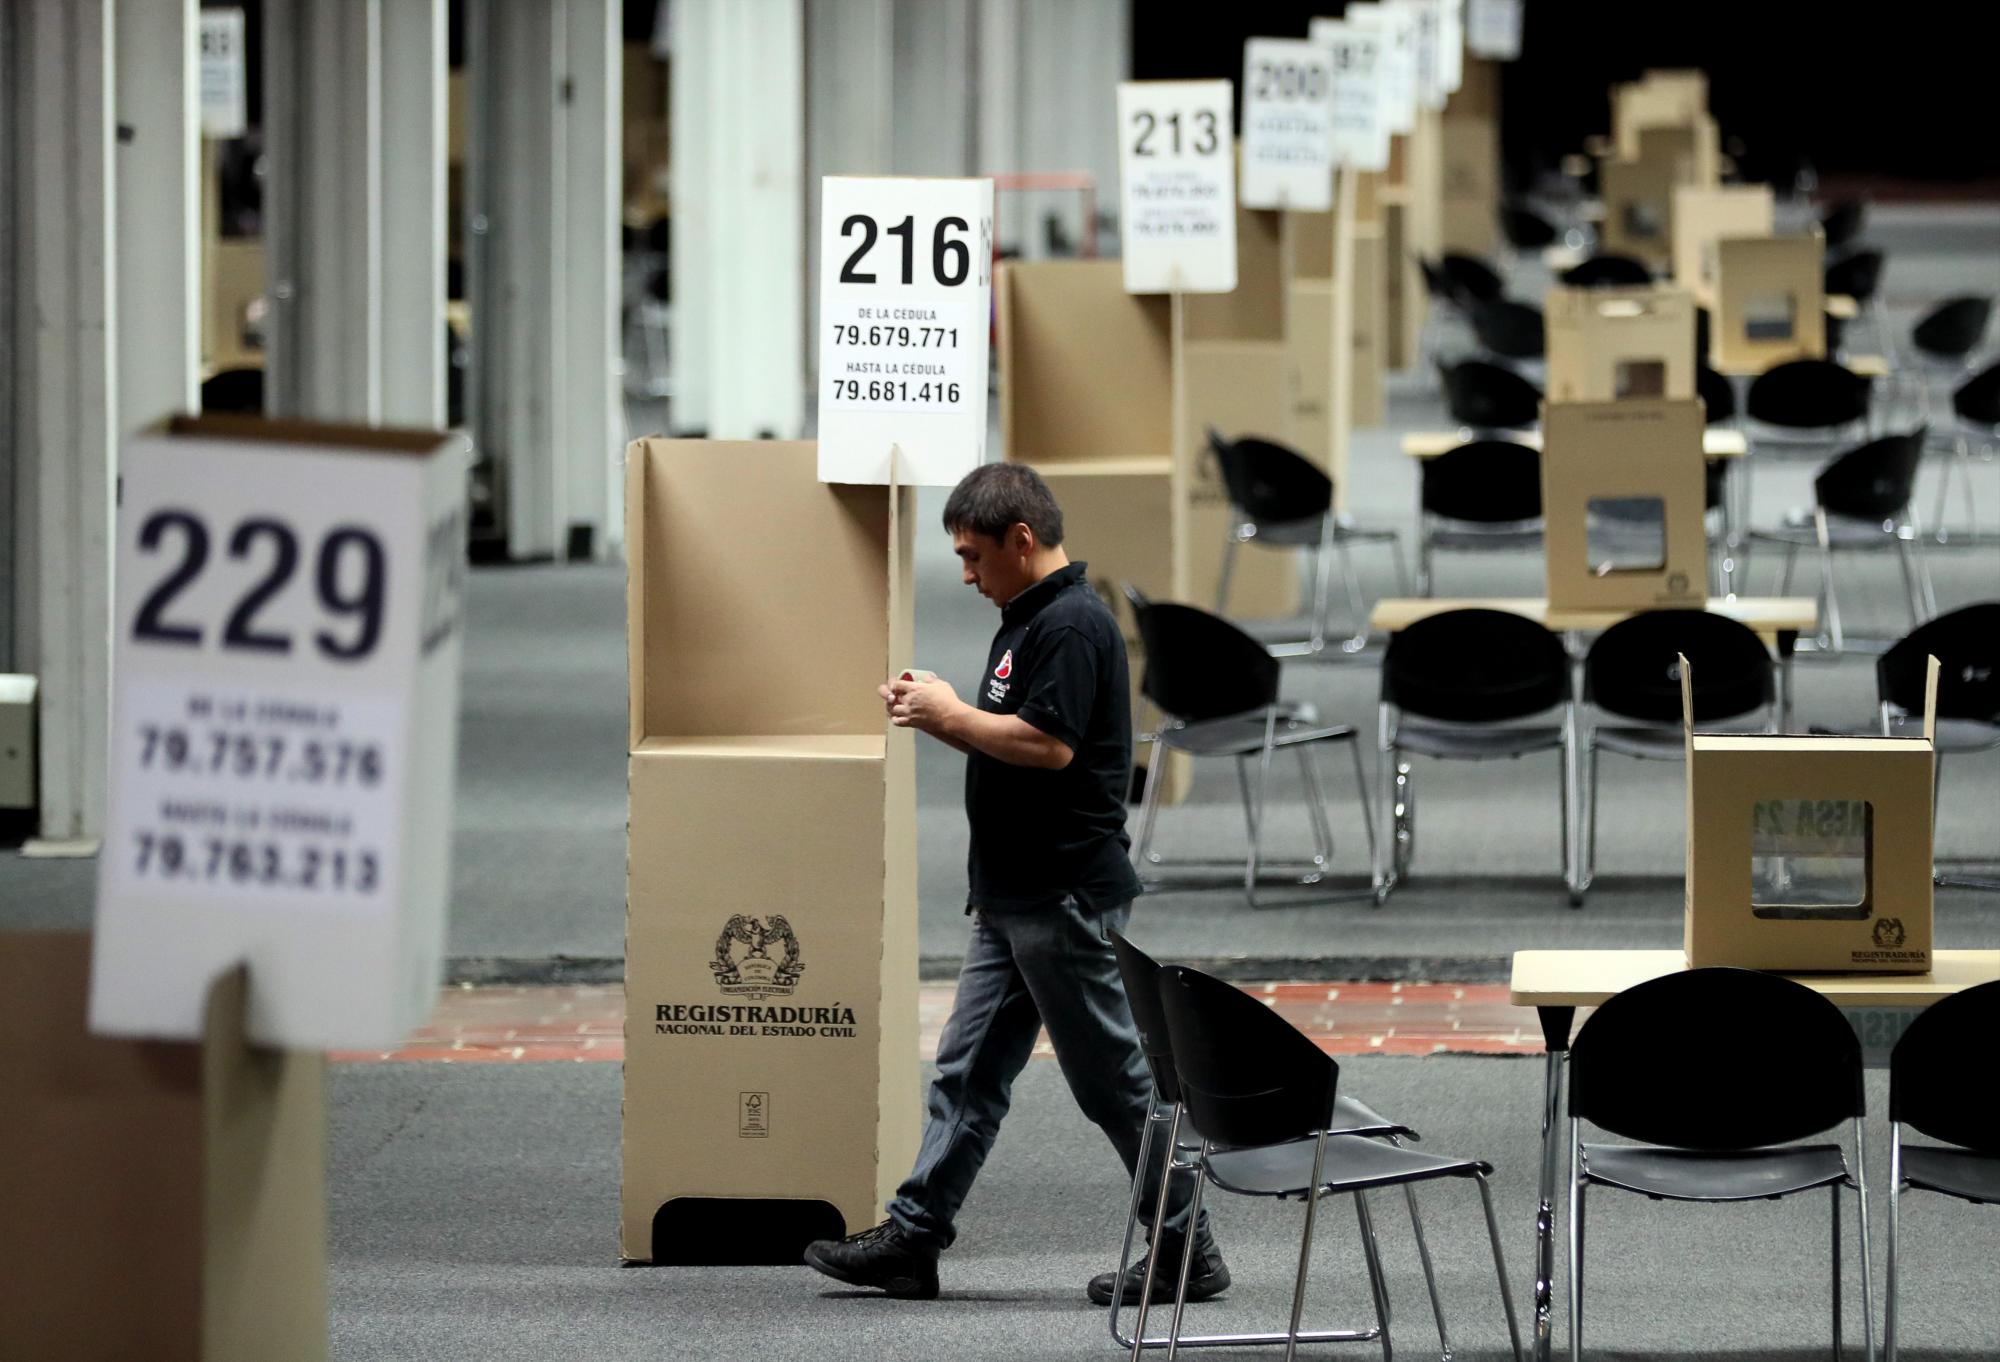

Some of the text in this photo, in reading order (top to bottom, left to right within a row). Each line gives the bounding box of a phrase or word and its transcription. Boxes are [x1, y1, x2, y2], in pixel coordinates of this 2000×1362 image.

[1132, 108, 1218, 156] 213
[840, 214, 970, 287] 216
[858, 308, 871, 319] DE
[877, 309, 889, 320] LA
[833, 325, 958, 348] 79.679.771
[847, 362, 881, 374] HASTA
[885, 364, 898, 375] LA
[833, 380, 960, 403] 79.681.416
[131, 509, 388, 664] 229
[139, 728, 384, 790] 79.757.576
[134, 834, 380, 894] 79.763.213
[656, 1002, 856, 1025] REGISTRADURÍA
[655, 1024, 857, 1038] NACIONAL DEL ESTADO CIVIL
